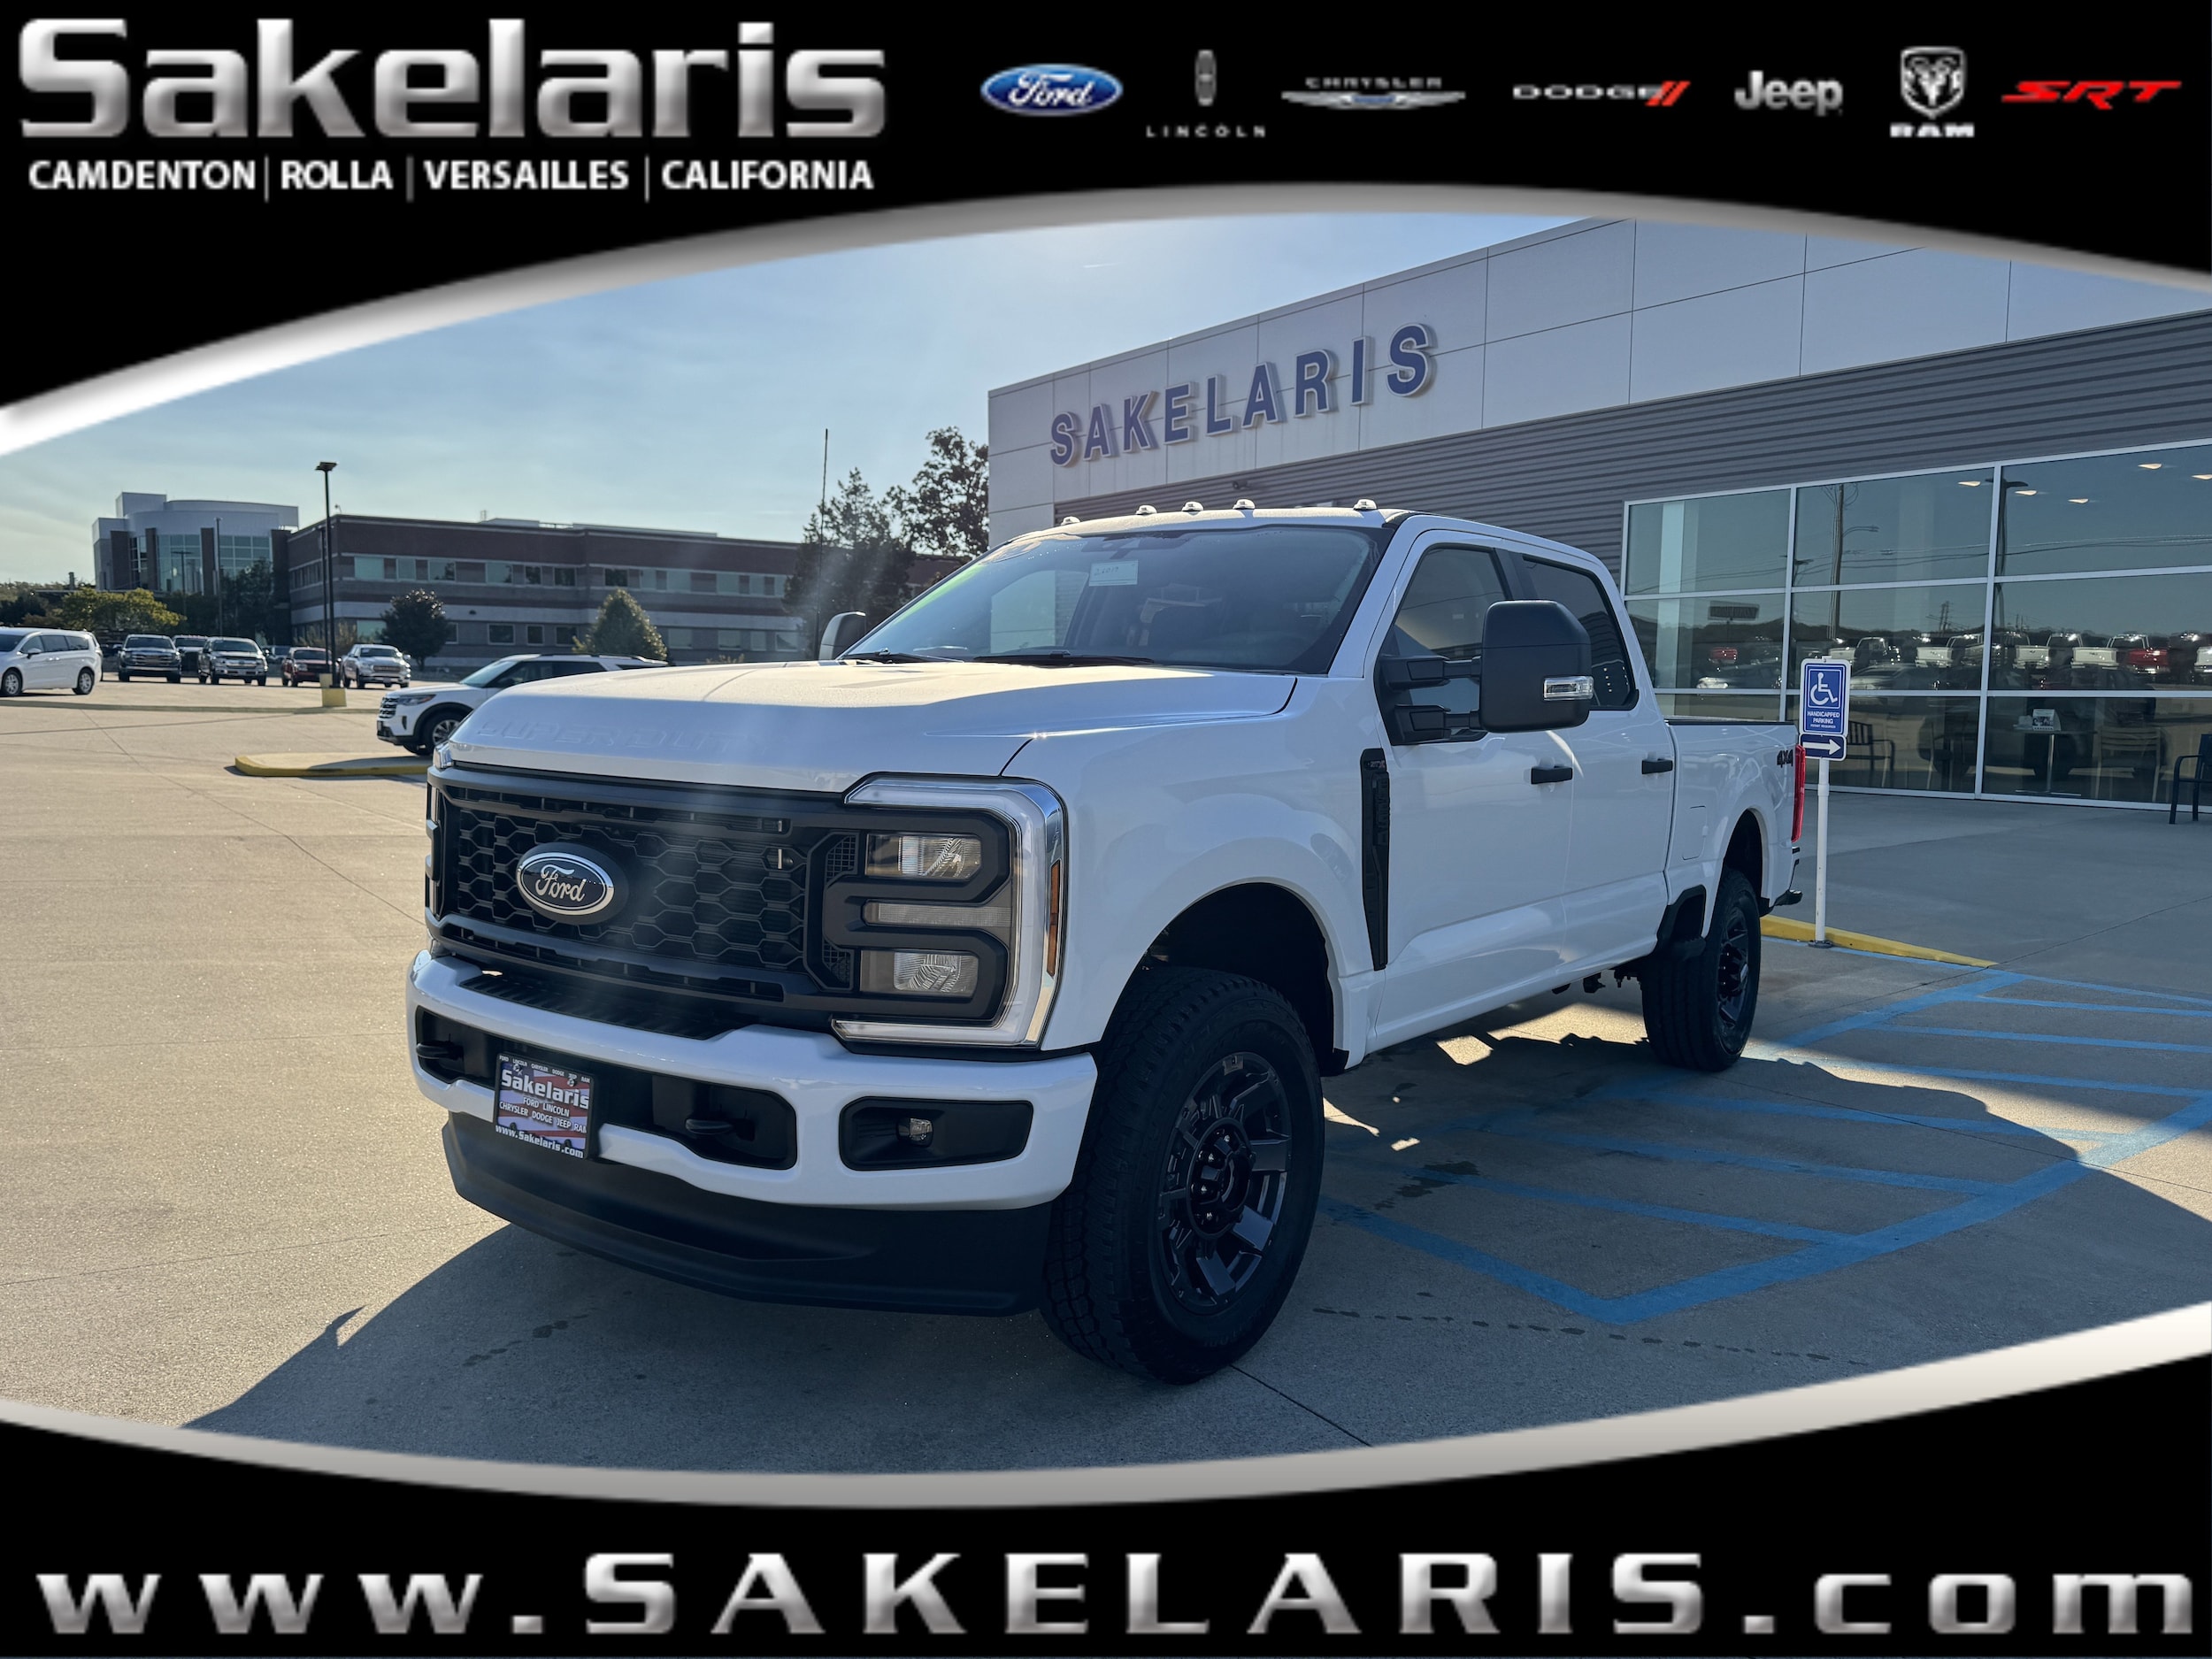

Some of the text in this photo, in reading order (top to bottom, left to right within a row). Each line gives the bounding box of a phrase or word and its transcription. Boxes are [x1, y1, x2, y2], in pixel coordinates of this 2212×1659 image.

[1050, 323, 1436, 467] SAKELARIS
[535, 864, 588, 902] Ford
[501, 1069, 589, 1110] Sakelaris
[523, 1096, 570, 1118] FORD LINCOLN
[499, 1102, 529, 1117] CHRYSLER
[532, 1110, 553, 1124] DODGE
[557, 1118, 572, 1130] JEEP
[495, 1125, 584, 1159] www.Sakelaris.com
